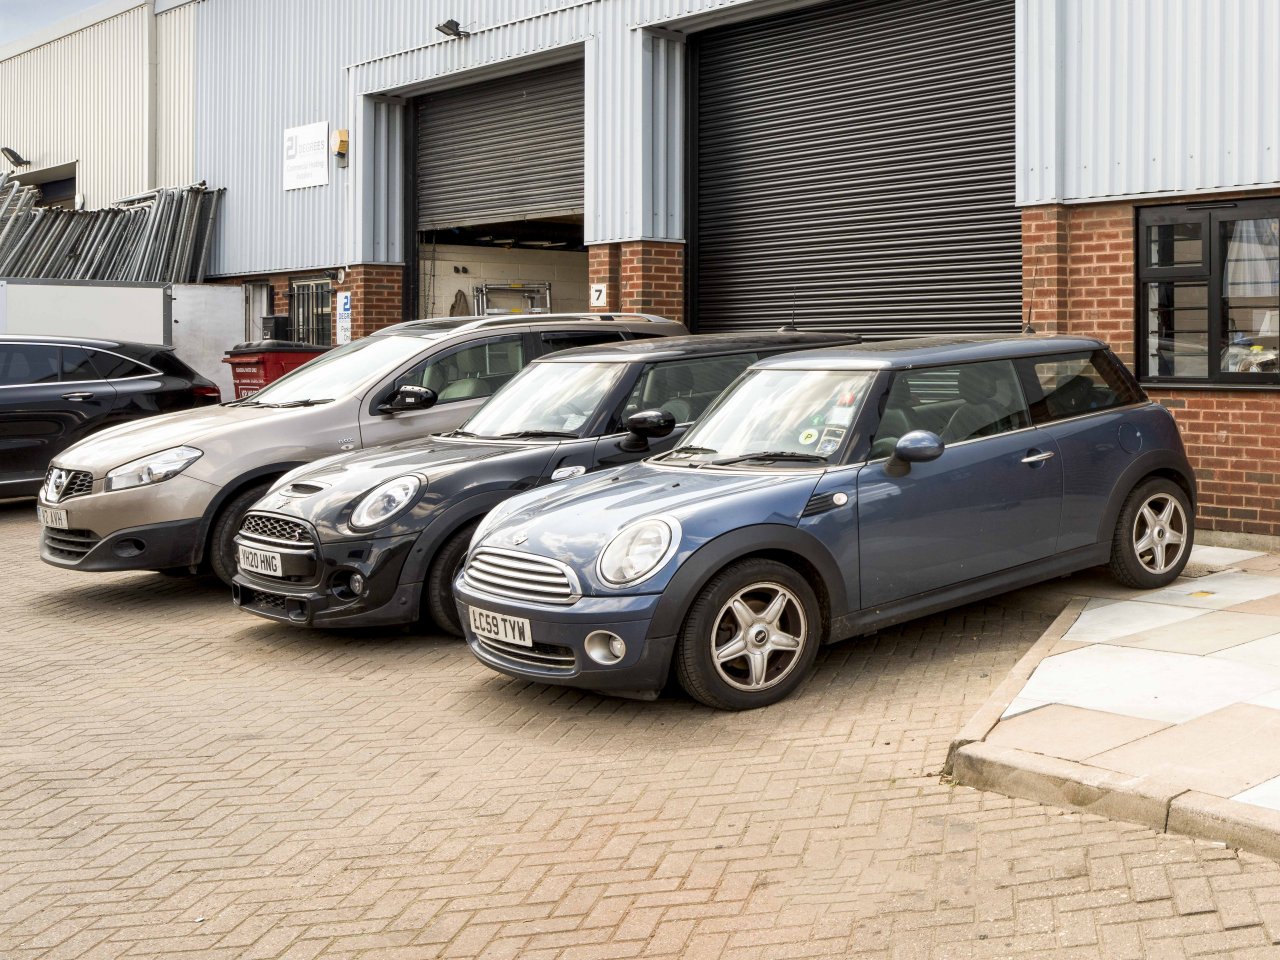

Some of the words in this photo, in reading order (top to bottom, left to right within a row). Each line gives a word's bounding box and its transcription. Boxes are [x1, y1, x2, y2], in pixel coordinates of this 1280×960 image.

[594, 289, 603, 302] 7
[260, 554, 277, 572] HNG
[472, 609, 500, 636] LC59
[500, 617, 526, 642] TYW
